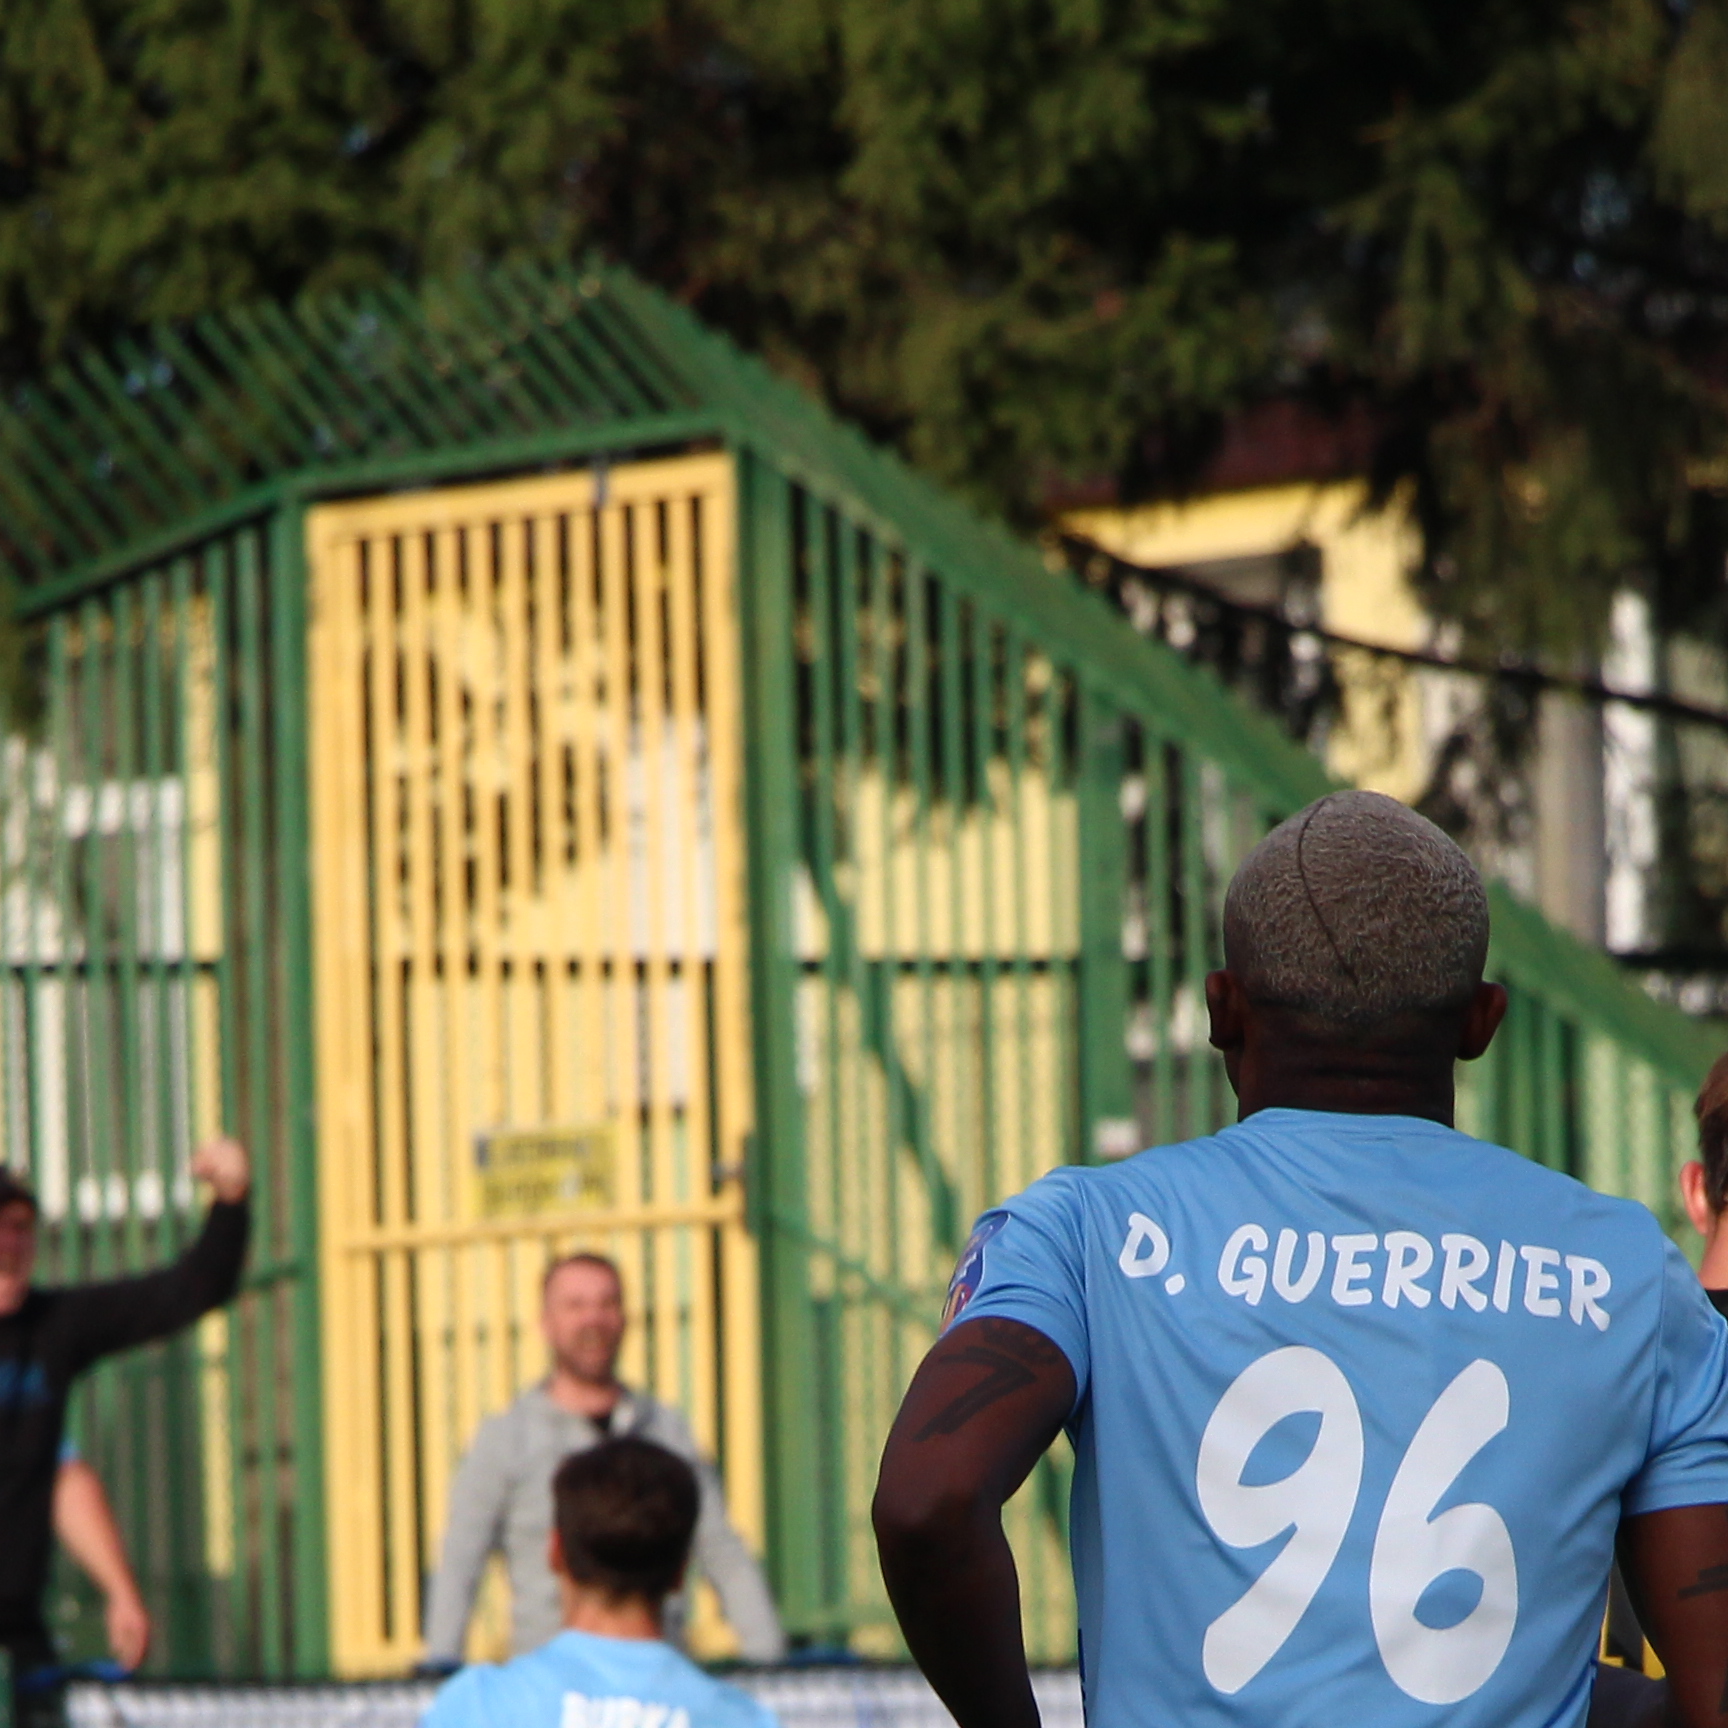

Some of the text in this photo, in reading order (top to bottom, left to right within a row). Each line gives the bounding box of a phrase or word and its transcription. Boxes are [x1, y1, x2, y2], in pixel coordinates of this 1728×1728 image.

[1117, 1211, 1186, 1296] D.
[1218, 1223, 1613, 1332] GUERRIER
[1195, 1345, 1519, 1704] 96
